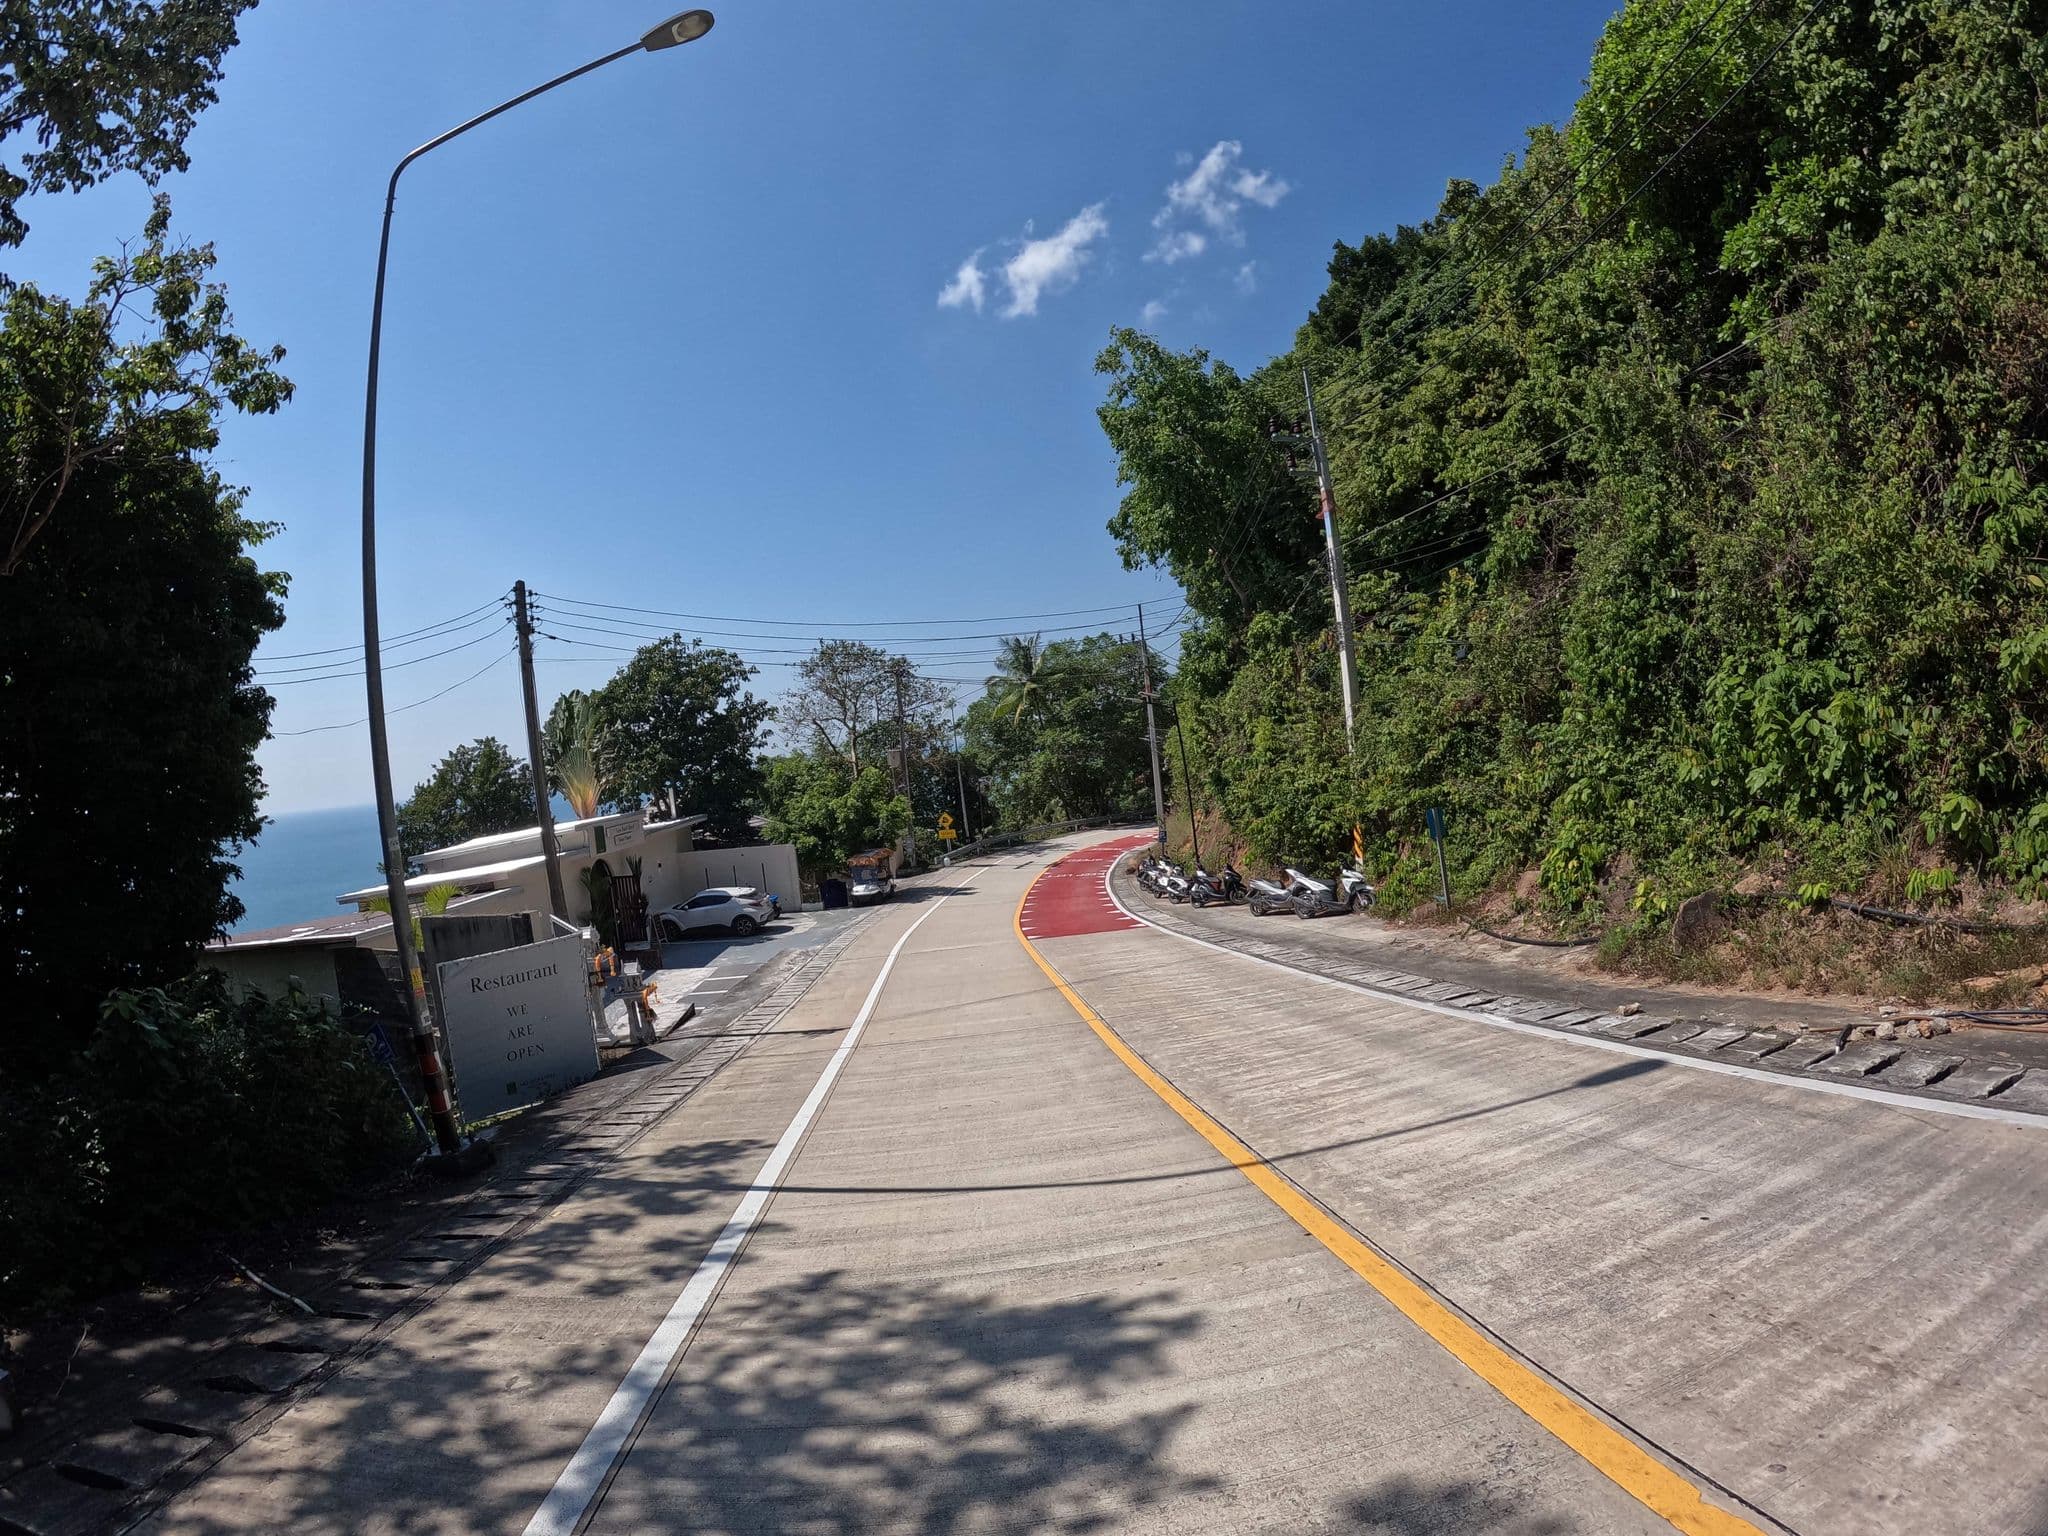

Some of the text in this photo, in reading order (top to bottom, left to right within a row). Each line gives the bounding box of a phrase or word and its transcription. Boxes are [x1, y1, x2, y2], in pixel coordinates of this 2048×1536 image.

[471, 964, 559, 993] Restaurant
[507, 1003, 529, 1017] WE
[507, 1024, 535, 1041] ARE
[507, 1043, 545, 1062] OPEN
